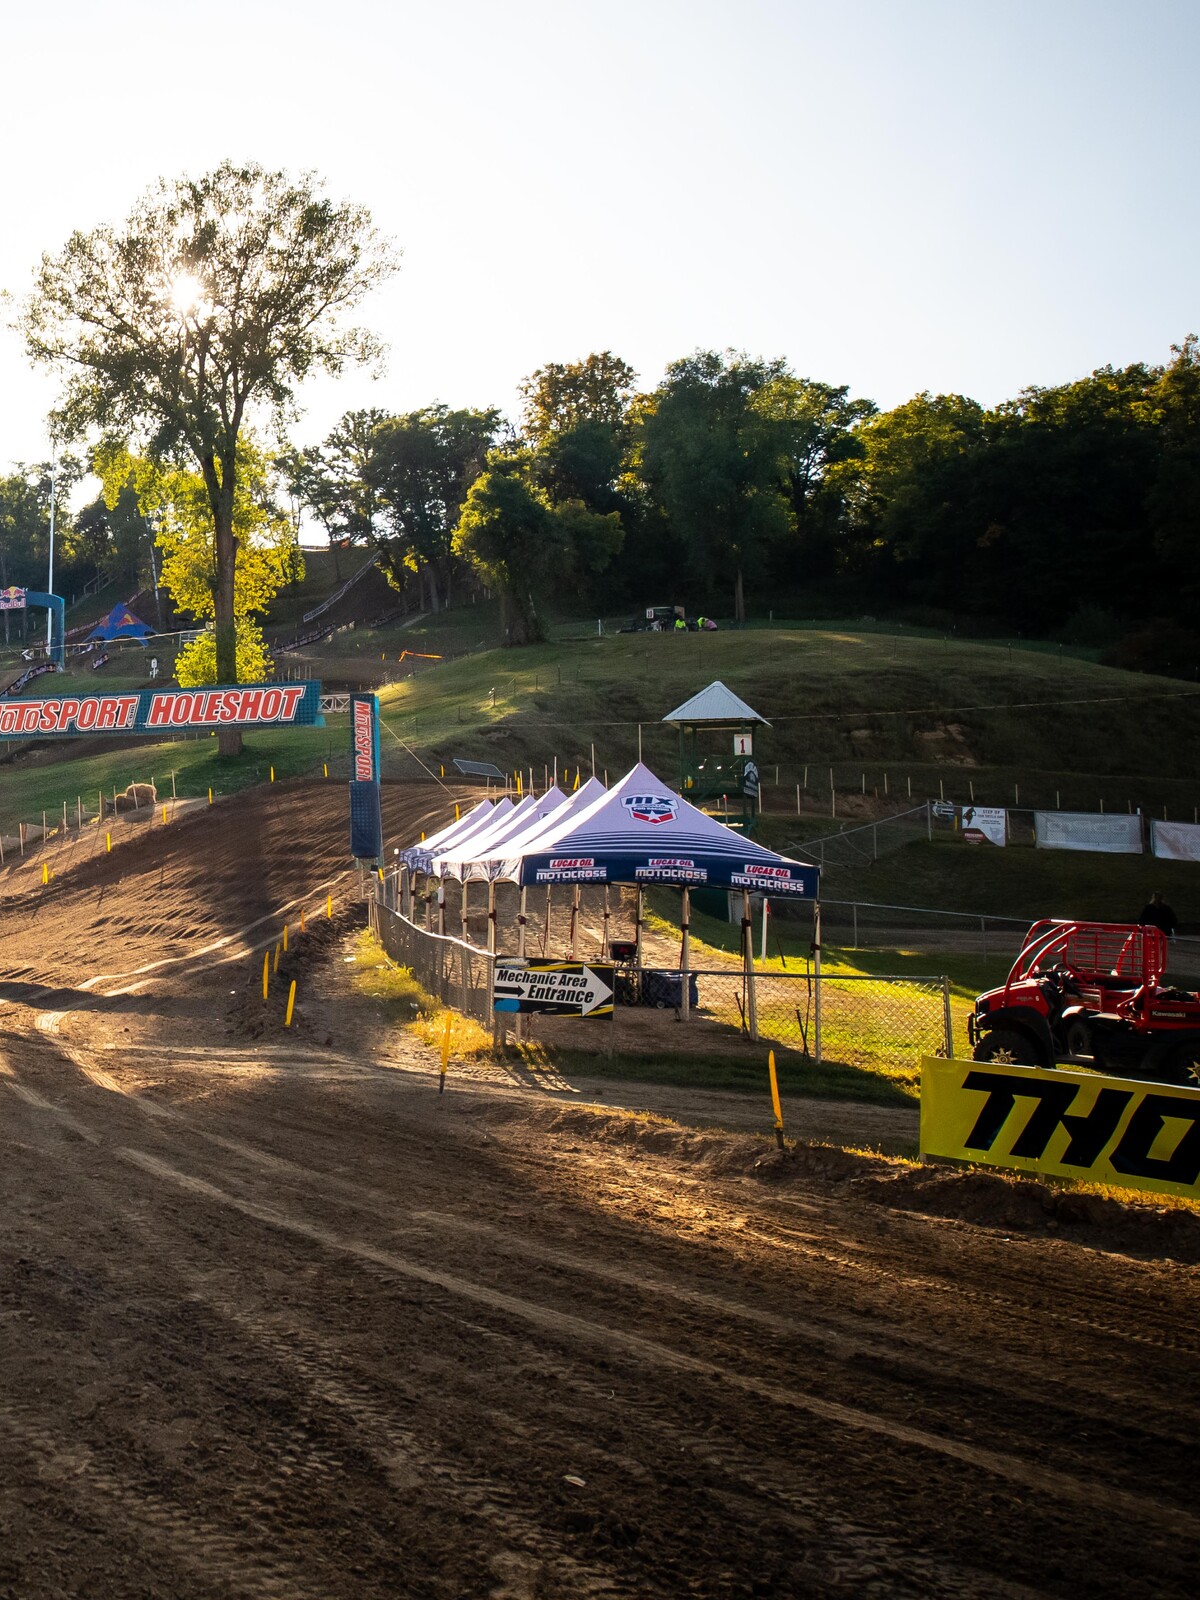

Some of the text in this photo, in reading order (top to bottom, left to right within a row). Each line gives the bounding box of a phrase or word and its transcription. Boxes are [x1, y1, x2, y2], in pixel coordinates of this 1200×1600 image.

[148, 688, 304, 726] HOLESHOT
[740, 738, 746, 753] 1
[552, 858, 593, 867] LUCAS OIL
[679, 859, 693, 867] OIL
[536, 870, 607, 880] MOTOCROSS
[635, 869, 708, 880] MOTOCROSS
[746, 866, 789, 878] LUCAS OIL
[731, 875, 804, 892] MOTOCROSS
[497, 969, 588, 988] Mechanic Area
[527, 984, 595, 1003] Entrance
[1152, 1010, 1186, 1018] Kawasaki
